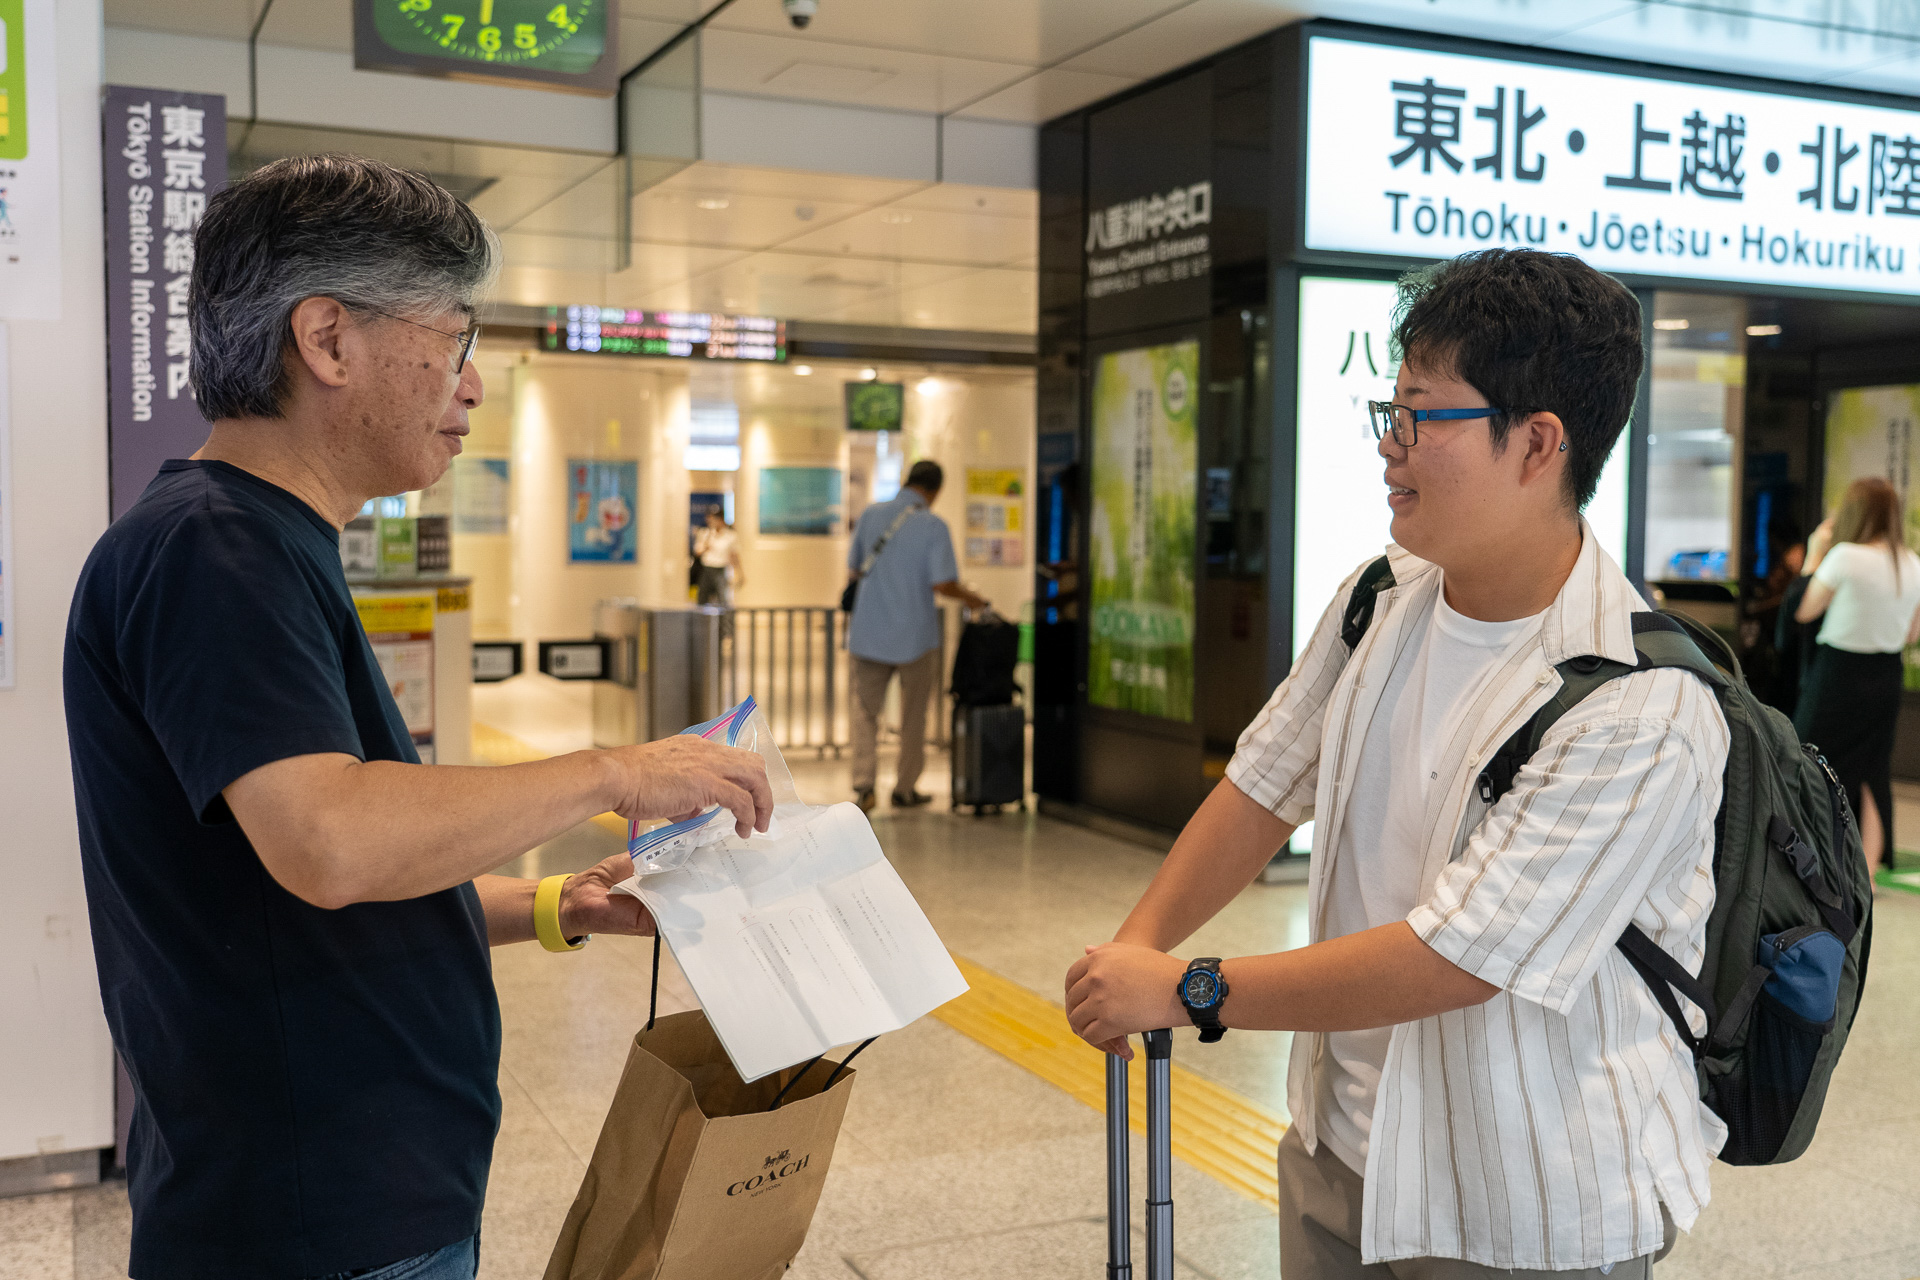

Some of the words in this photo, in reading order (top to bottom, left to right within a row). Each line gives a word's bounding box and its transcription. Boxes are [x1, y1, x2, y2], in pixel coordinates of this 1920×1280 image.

[441, 14, 465, 40] 7
[546, 3, 571, 28] 4
[477, 26, 501, 52] 6
[514, 23, 537, 49] 5
[122, 101, 152, 180] Tōkyō
[128, 184, 155, 274] Station
[130, 279, 157, 422] Information
[726, 1153, 810, 1197] COACH
